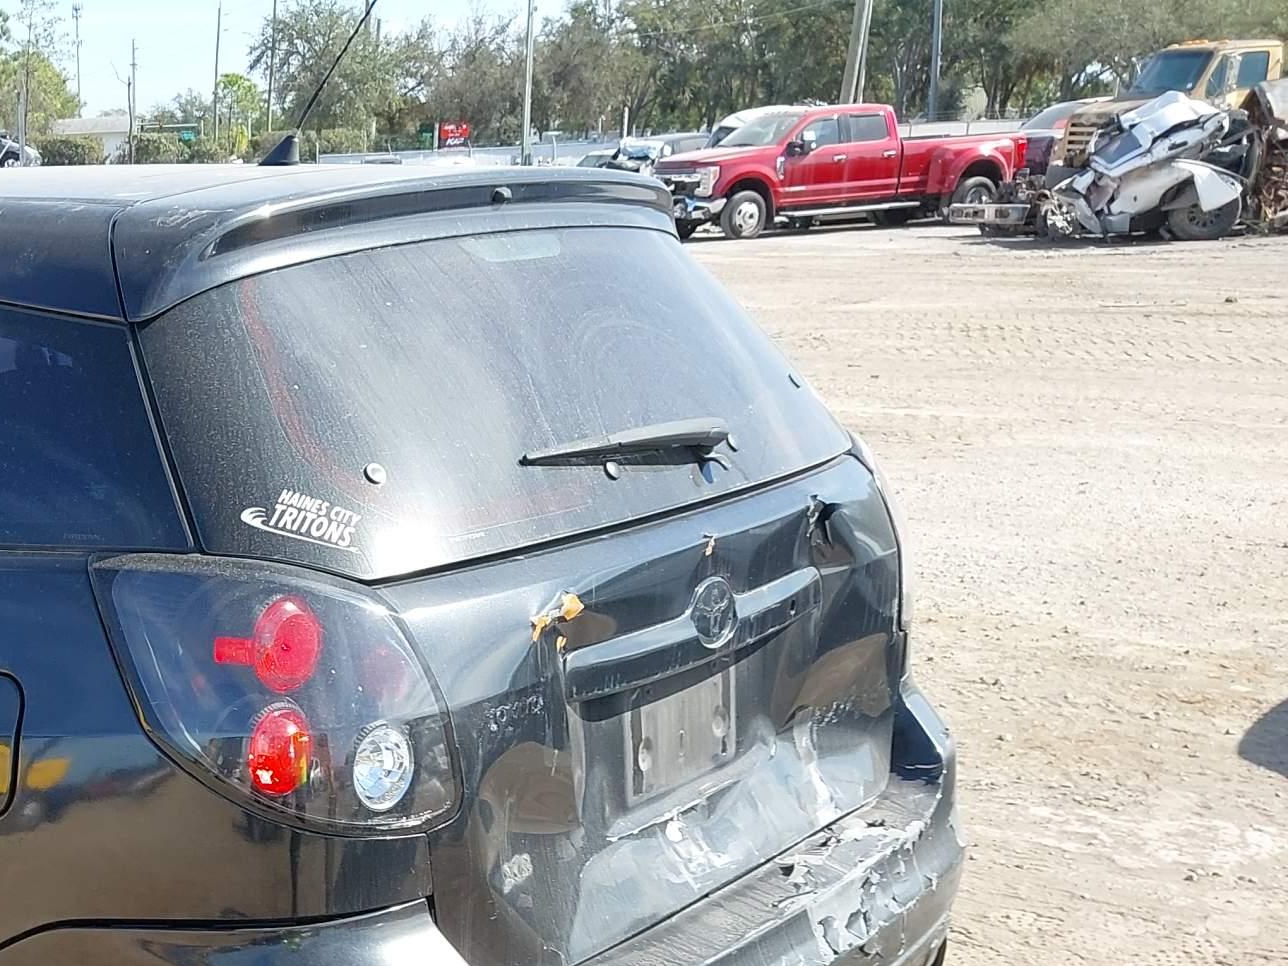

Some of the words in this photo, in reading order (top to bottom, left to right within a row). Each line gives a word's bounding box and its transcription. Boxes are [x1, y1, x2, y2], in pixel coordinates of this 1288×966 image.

[268, 503, 356, 547] TRITONS
[277, 488, 330, 516] HAINES
[330, 505, 362, 527] CITY
